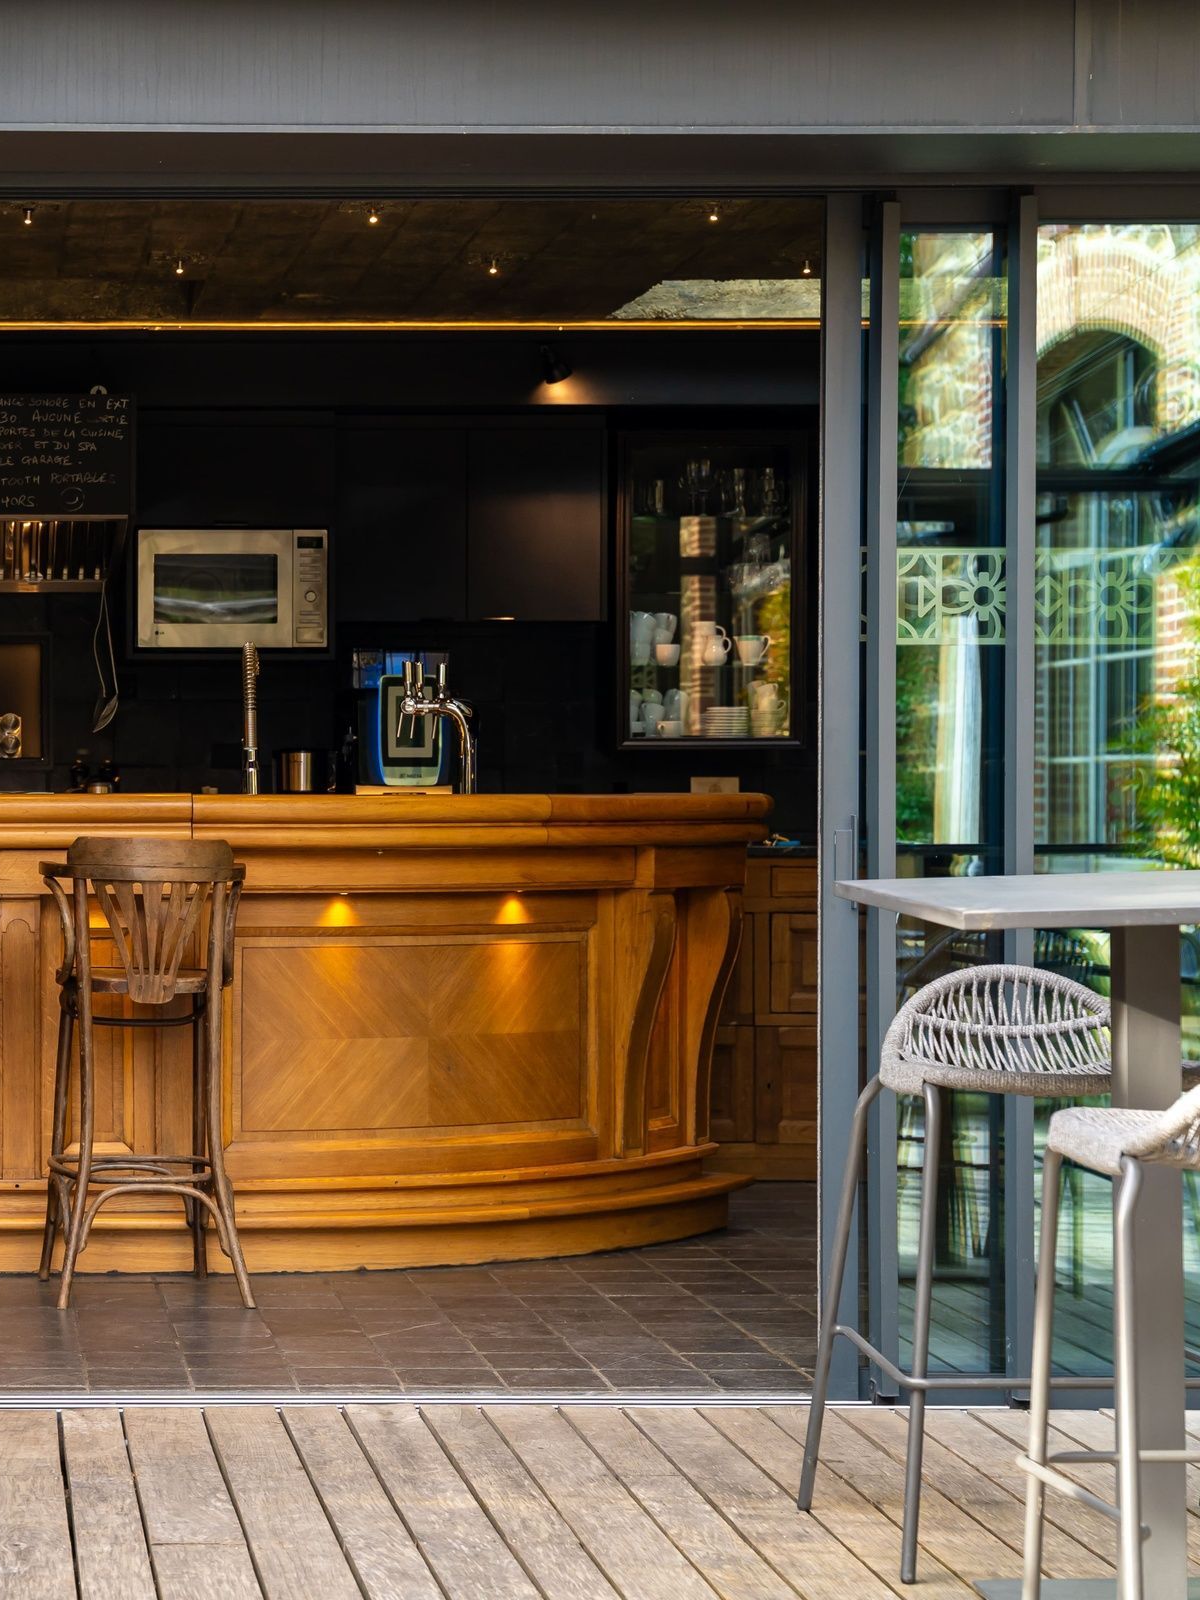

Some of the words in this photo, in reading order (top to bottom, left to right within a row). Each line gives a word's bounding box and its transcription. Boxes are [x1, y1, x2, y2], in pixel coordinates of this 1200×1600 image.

[28, 397, 70, 408] SONORE
[79, 399, 96, 409] EN
[32, 409, 81, 424] AUCUNE
[43, 428, 60, 438] DE
[63, 428, 76, 439] LA
[34, 441, 50, 450] ET
[52, 441, 70, 451] DU
[78, 442, 97, 452] SPA
[0, 456, 16, 466] LE
[50, 472, 117, 486] PORTABLES
